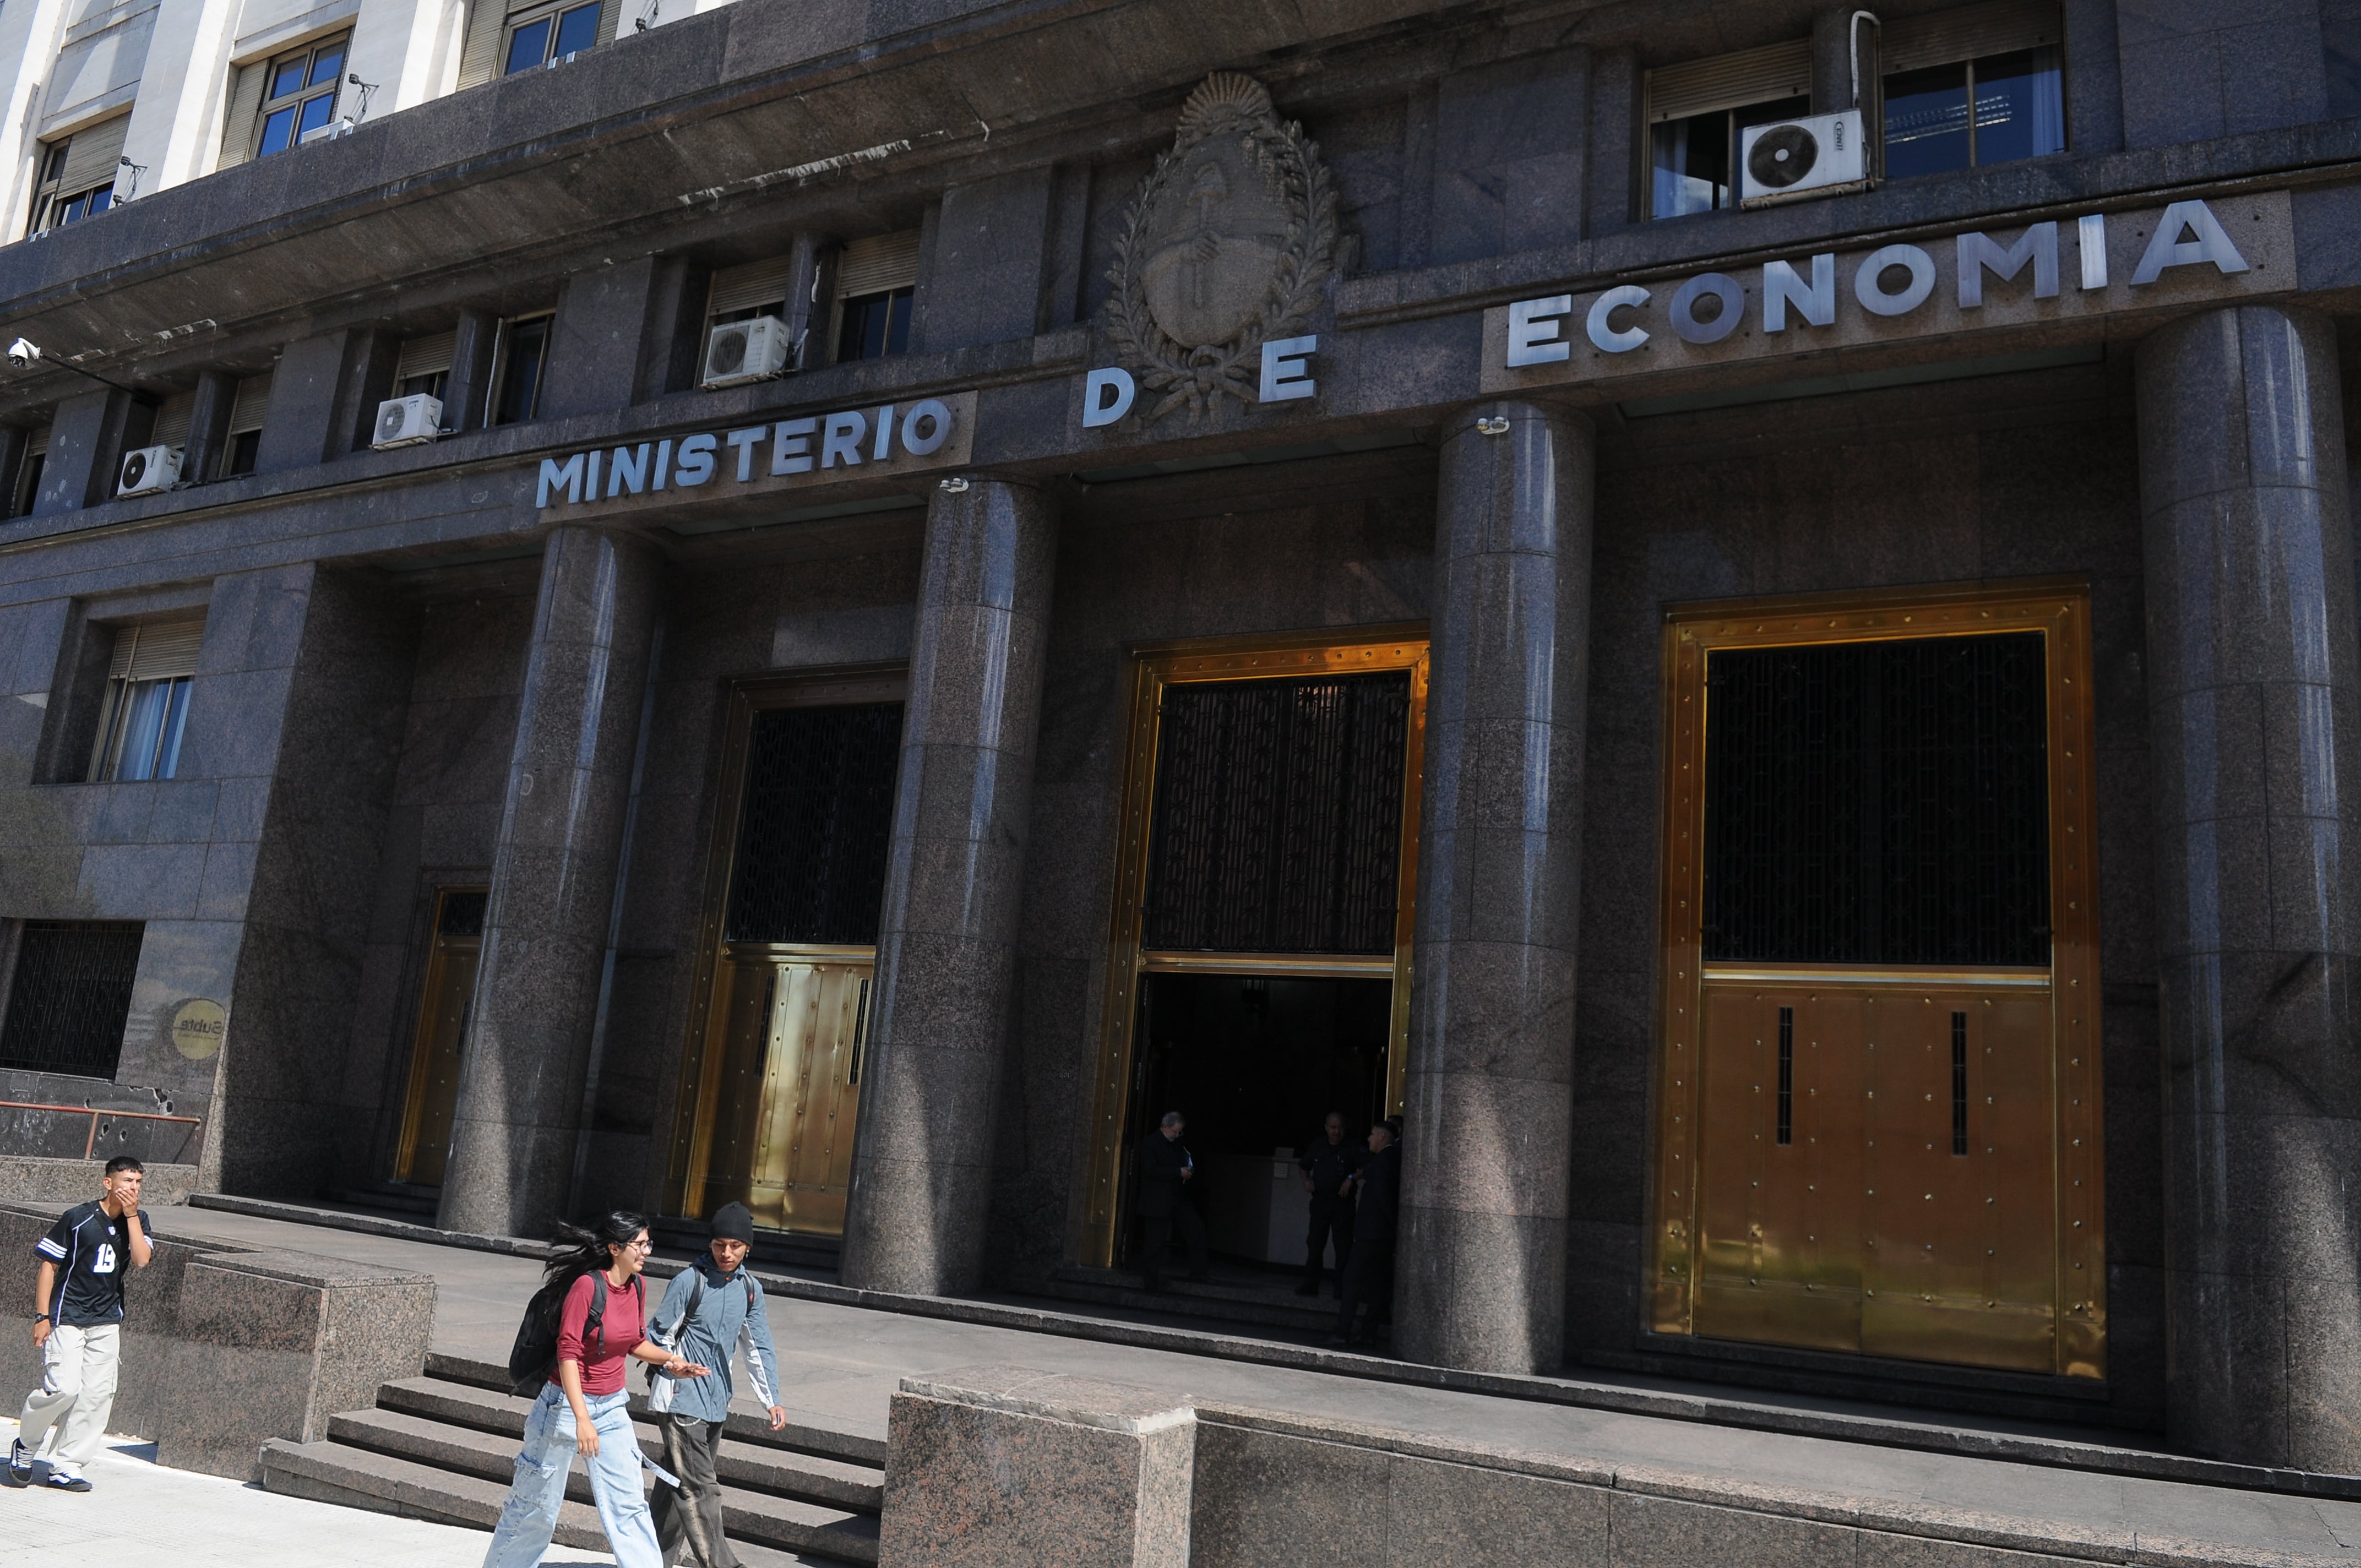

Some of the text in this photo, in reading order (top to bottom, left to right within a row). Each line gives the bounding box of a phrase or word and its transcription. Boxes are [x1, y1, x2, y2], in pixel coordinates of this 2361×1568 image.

[536, 399, 951, 509] MINISTERIO
[1506, 199, 2251, 368] ECONOMIA
[93, 1243, 116, 1273] 19
